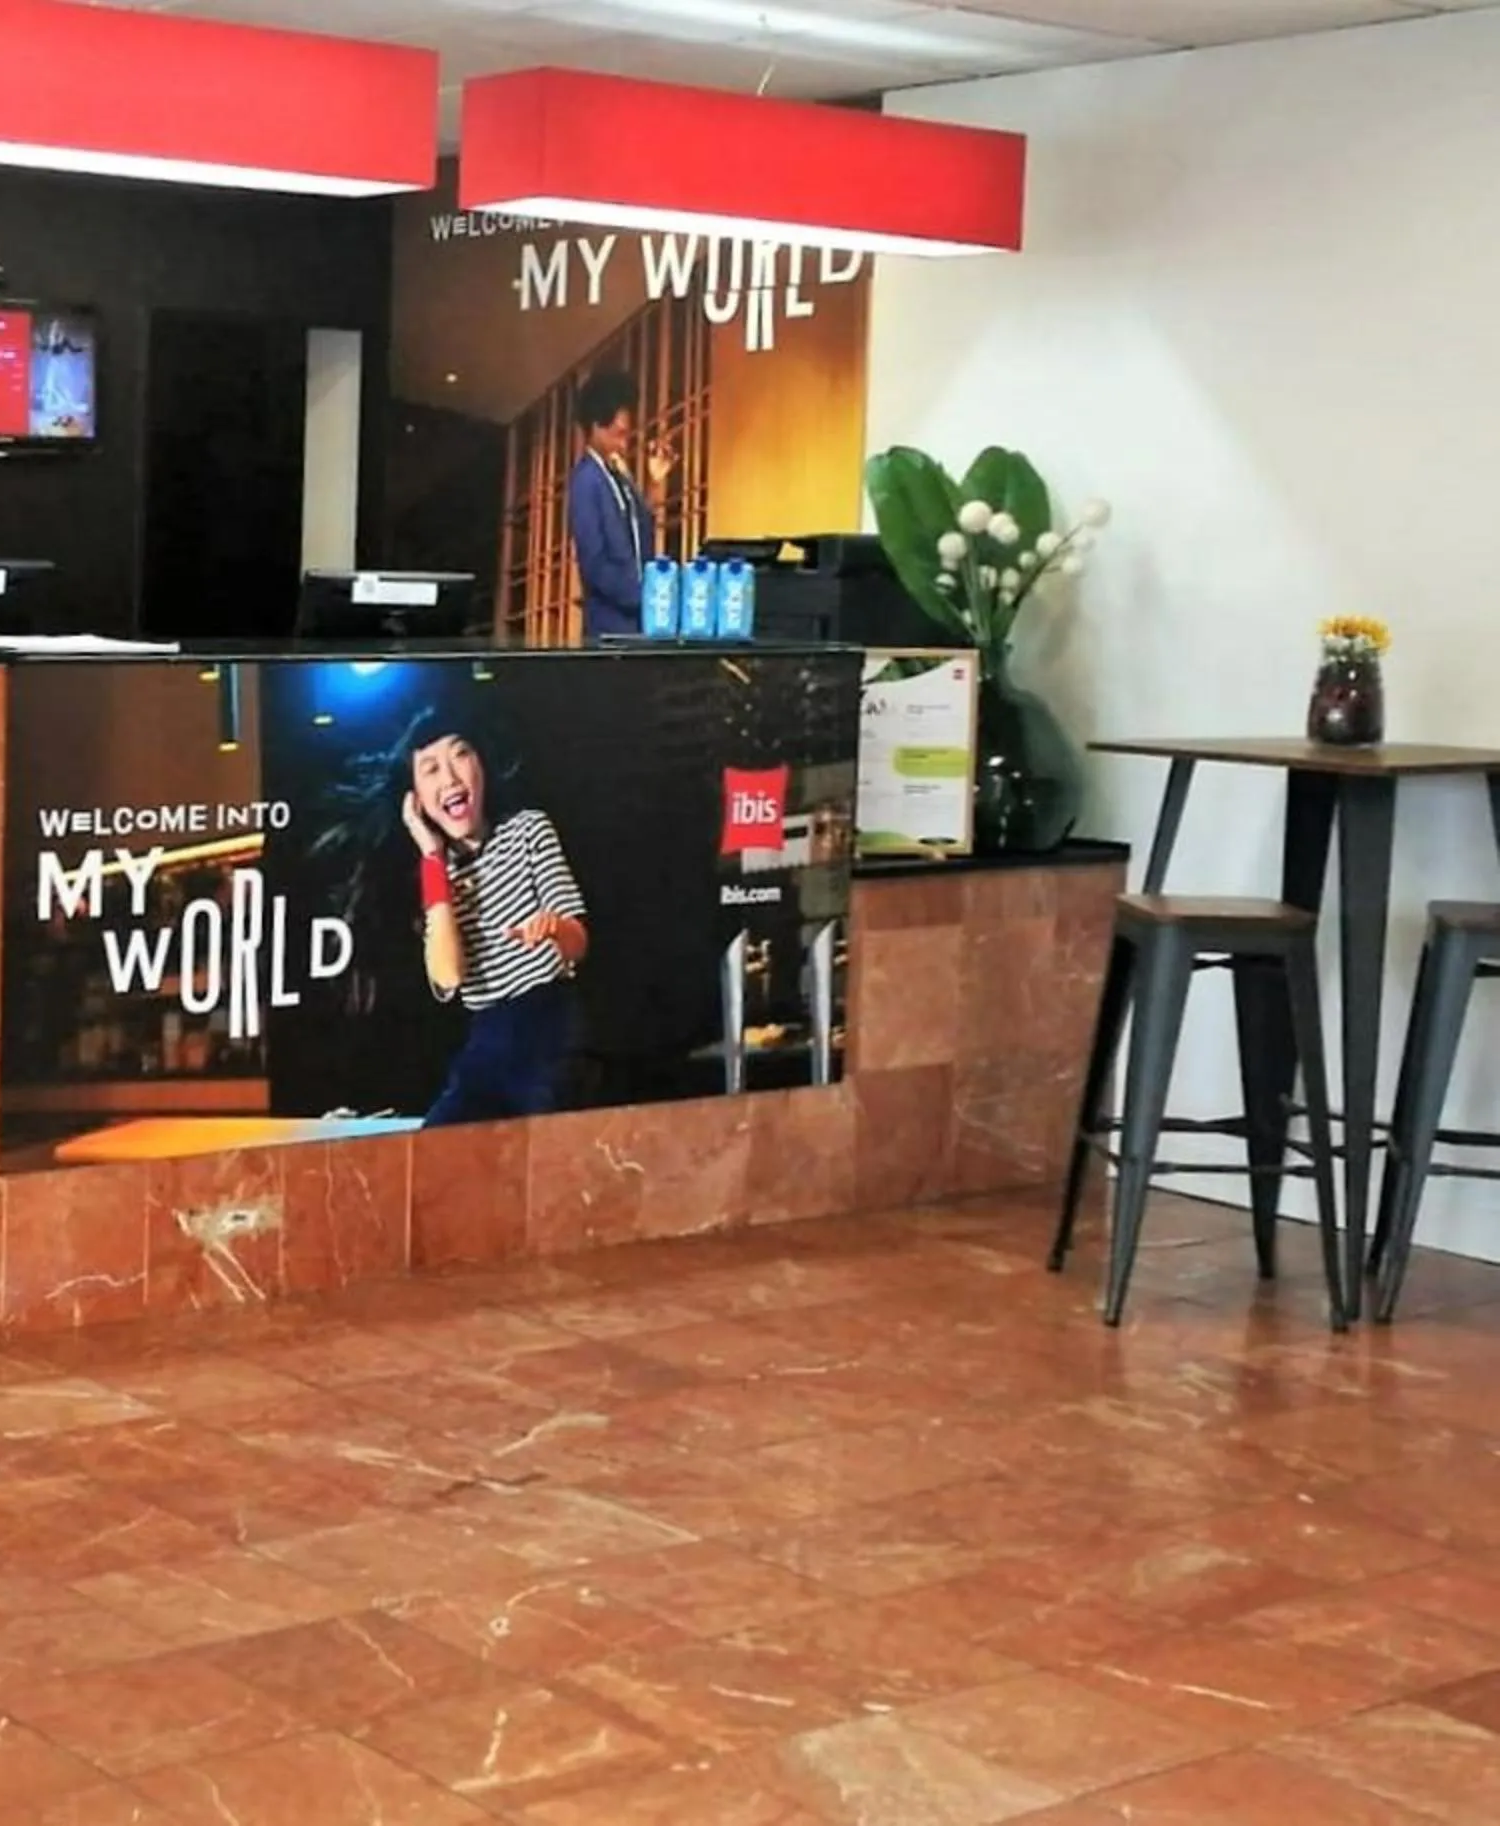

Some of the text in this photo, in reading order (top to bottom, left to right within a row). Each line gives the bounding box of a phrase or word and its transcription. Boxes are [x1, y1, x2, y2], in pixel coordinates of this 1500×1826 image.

[519, 234, 616, 310] MY
[39, 801, 291, 837] WELCOME INTO
[731, 790, 778, 824] ibis
[37, 845, 164, 921] MY
[103, 867, 353, 1038] WORLD
